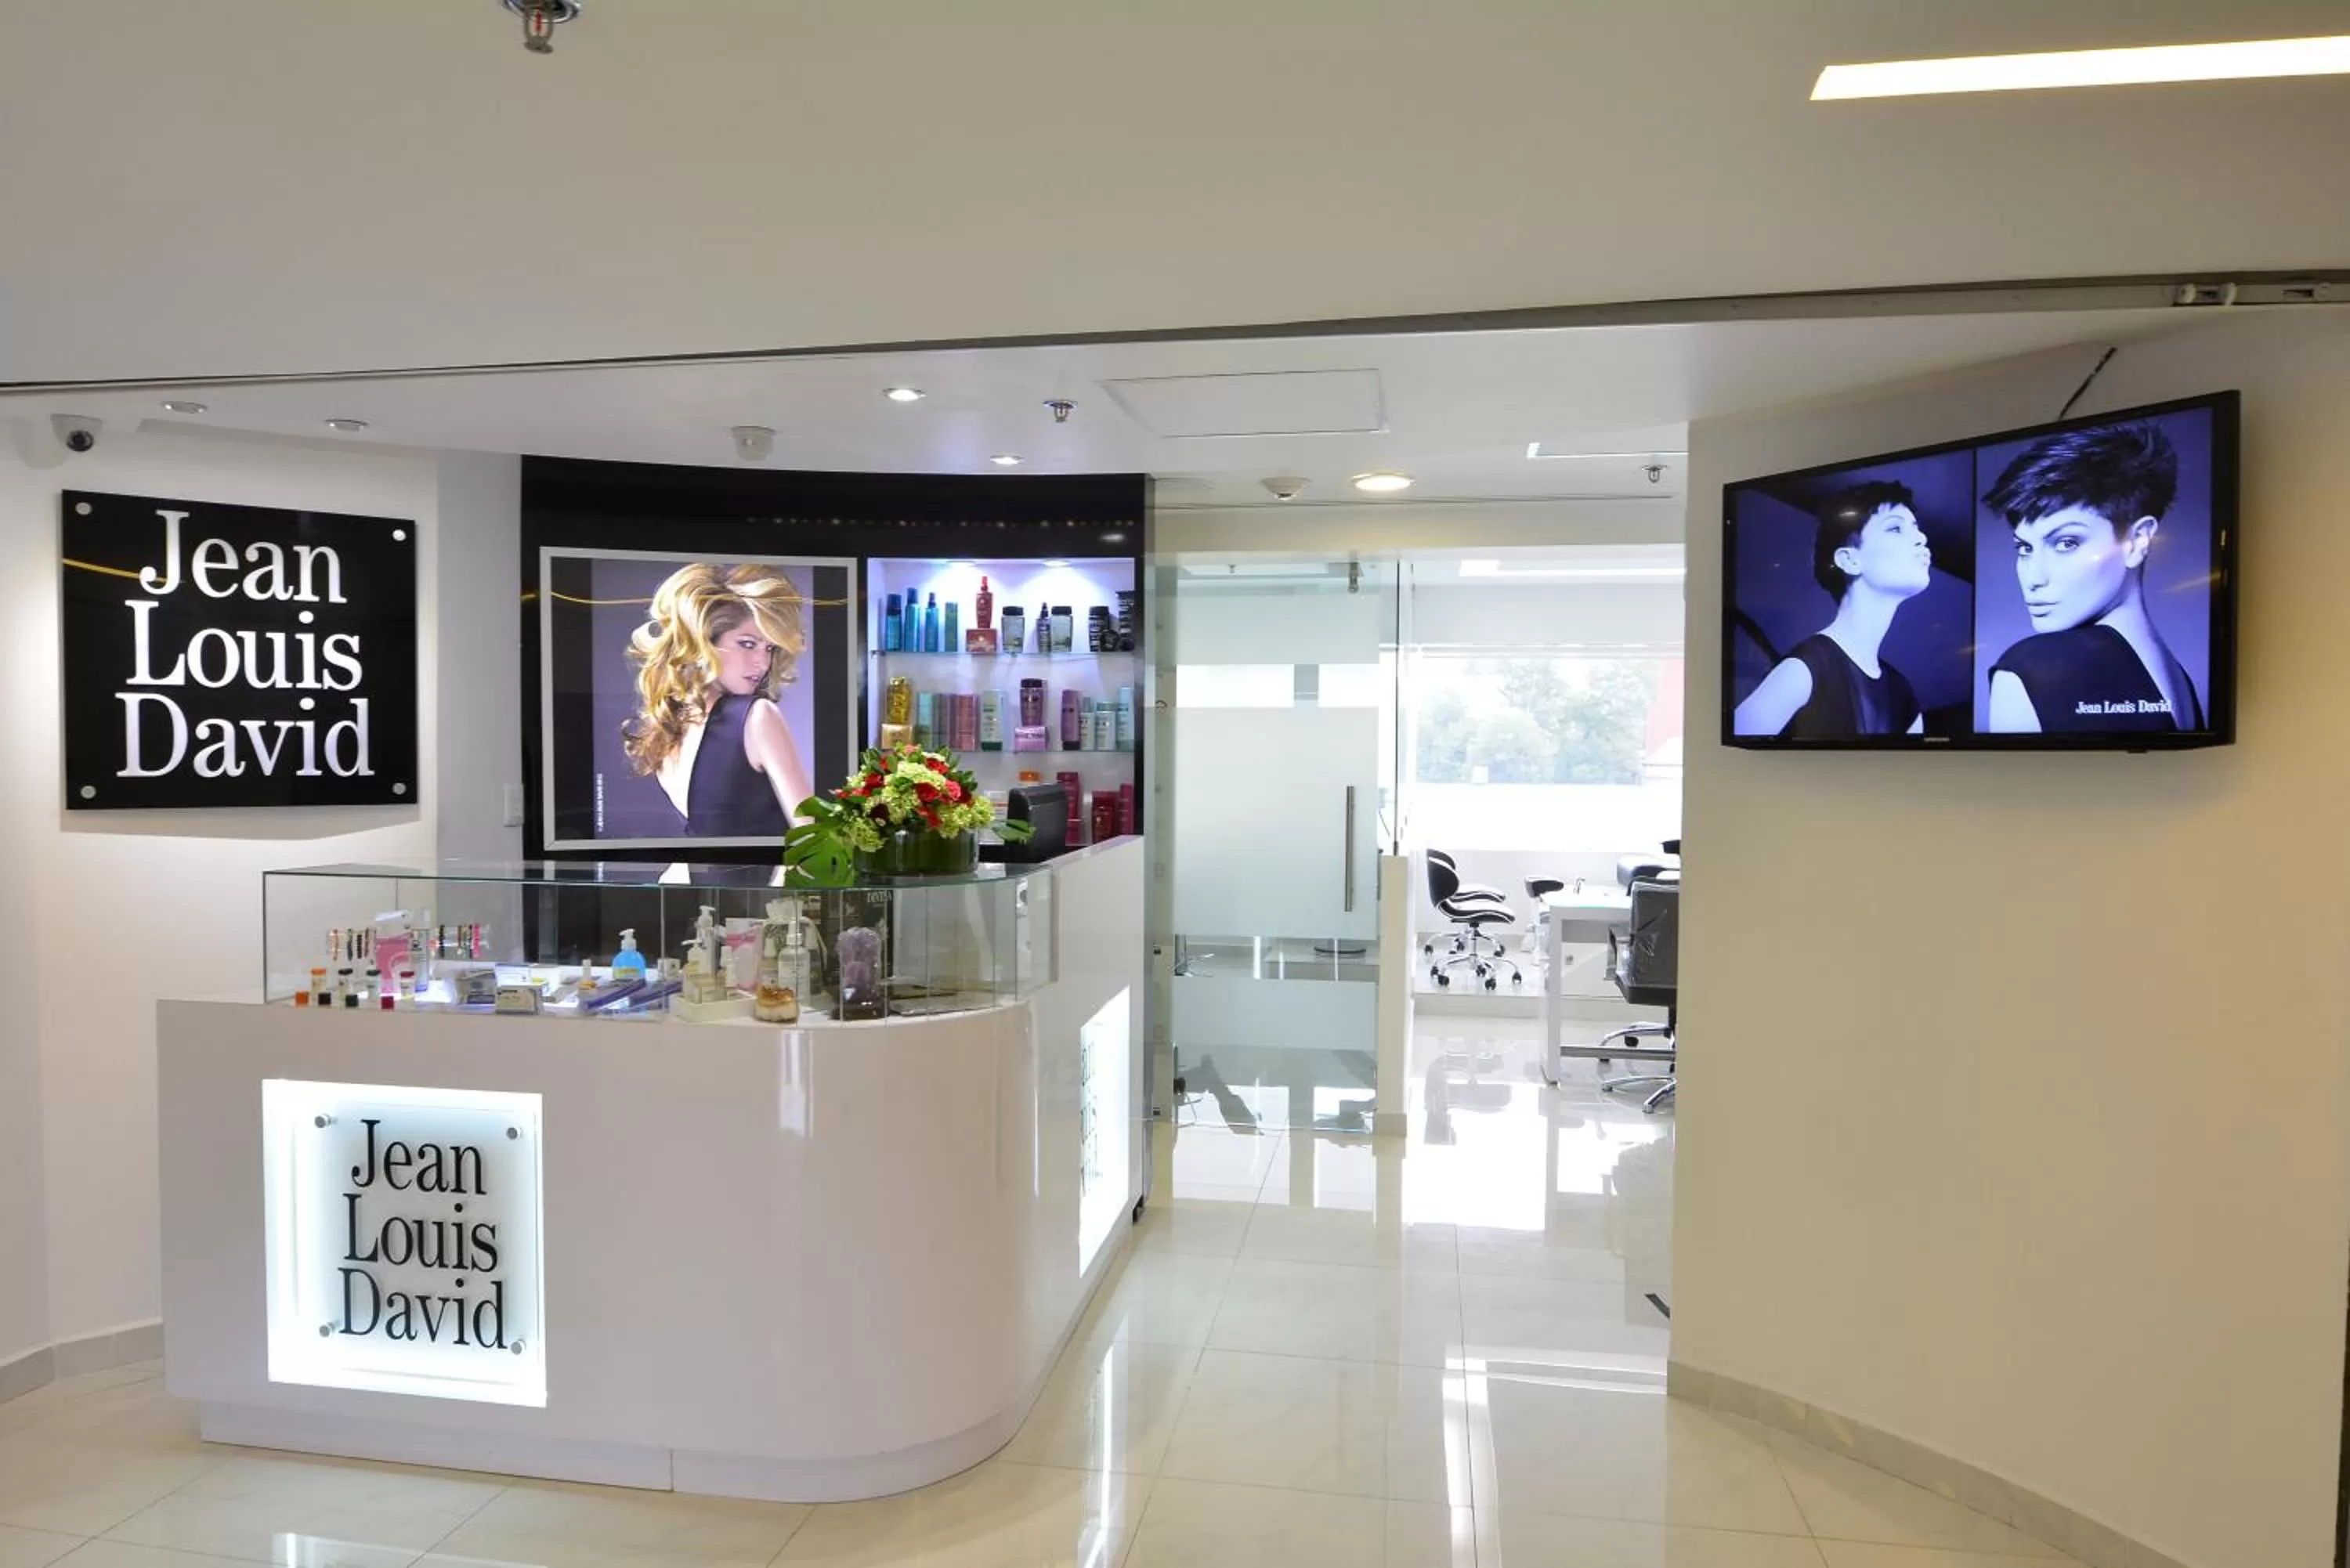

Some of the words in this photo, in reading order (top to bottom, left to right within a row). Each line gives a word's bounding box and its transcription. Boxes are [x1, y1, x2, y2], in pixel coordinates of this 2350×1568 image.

[139, 509, 347, 604] Jean
[124, 599, 363, 691] Louis
[115, 692, 376, 779] David
[2075, 701, 2102, 714] Jean
[2103, 699, 2135, 714] Louis
[2138, 699, 2172, 713] David
[351, 1118, 487, 1195] Jean
[342, 1193, 499, 1273] Louis
[337, 1266, 508, 1350] David
